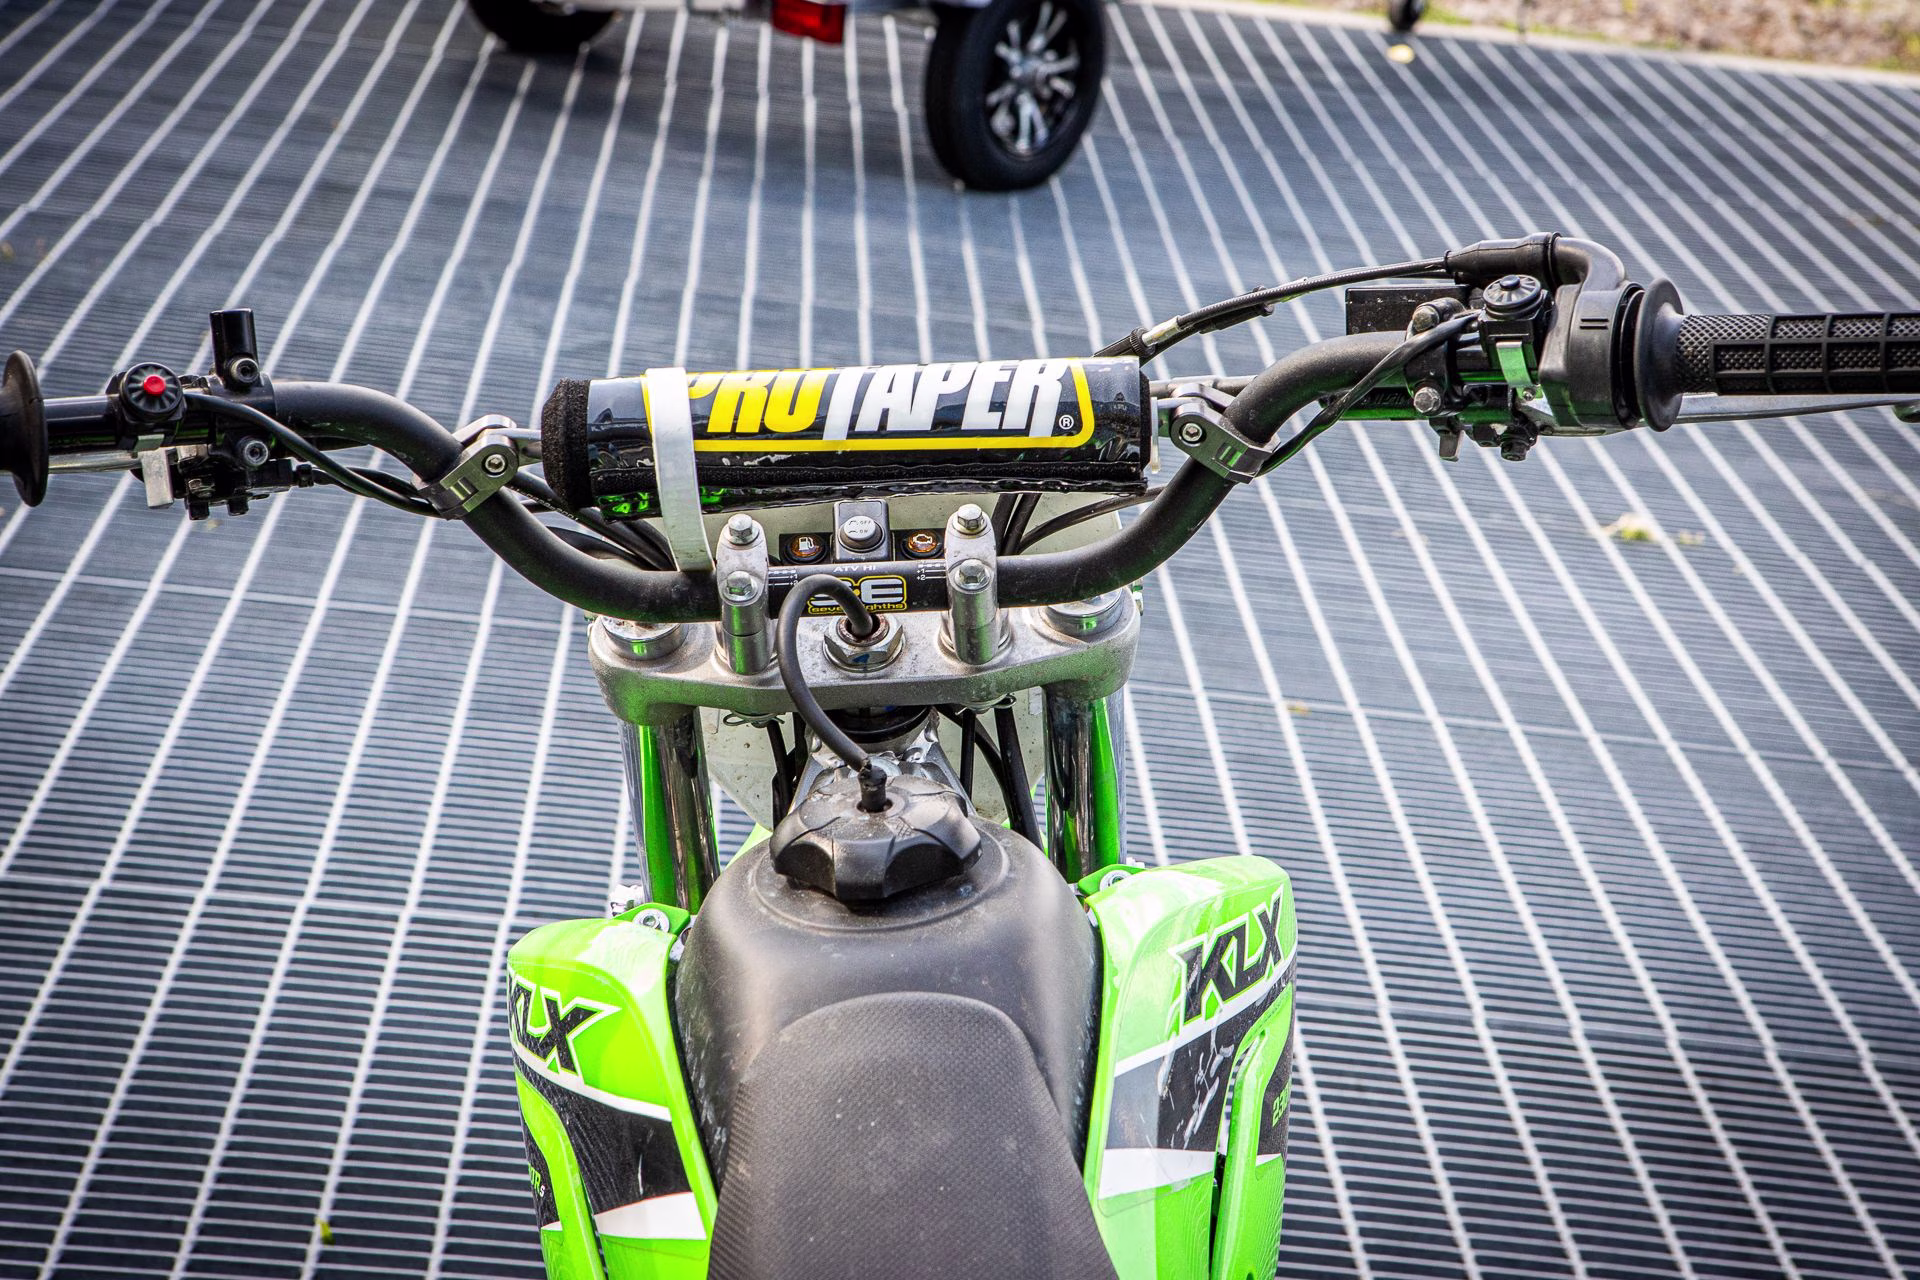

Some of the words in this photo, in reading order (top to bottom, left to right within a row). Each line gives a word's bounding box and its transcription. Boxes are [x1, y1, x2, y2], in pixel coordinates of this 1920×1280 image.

[833, 564, 860, 573] ATV
[1172, 889, 1284, 1026] KLX
[506, 970, 618, 1076] KLX
